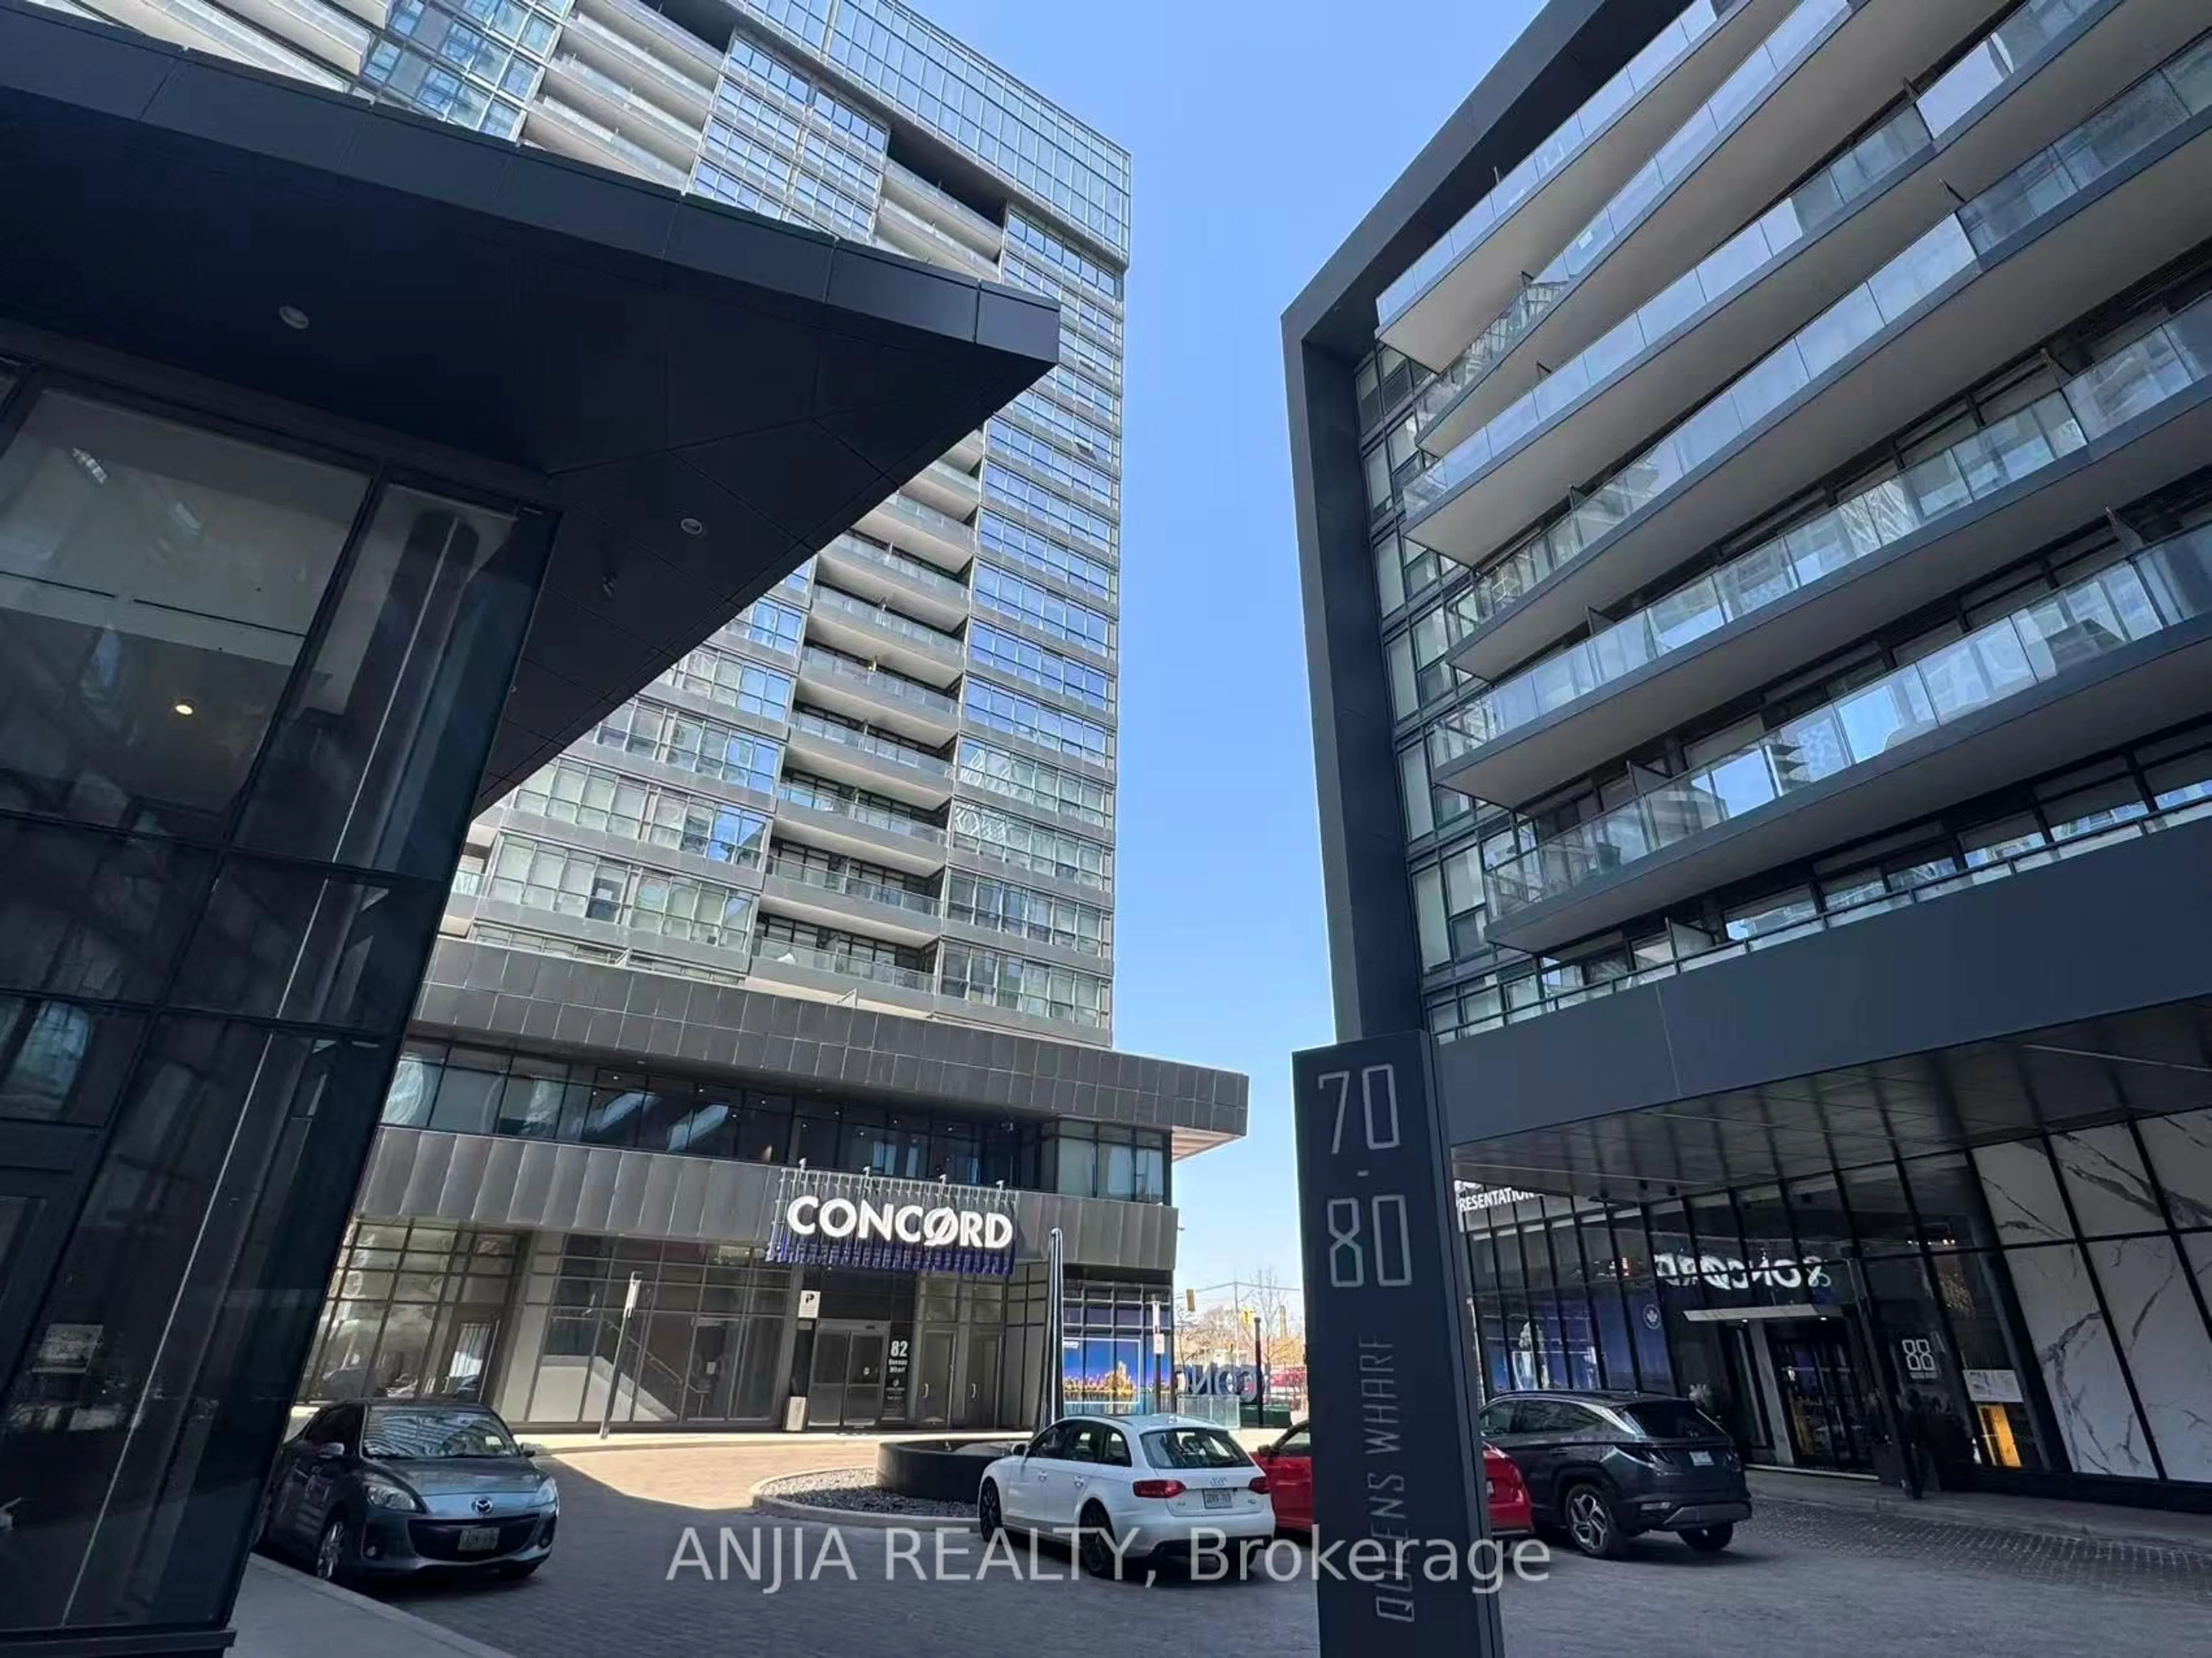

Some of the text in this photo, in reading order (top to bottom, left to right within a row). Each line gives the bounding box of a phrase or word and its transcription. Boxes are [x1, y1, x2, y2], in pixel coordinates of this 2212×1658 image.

[1317, 1063, 1402, 1155] 70
[1327, 1194, 1412, 1288] 80
[891, 1340, 908, 1357] 82
[1902, 1339, 1936, 1371] 88
[1358, 1334, 1415, 1623] QUEENS WHARF
